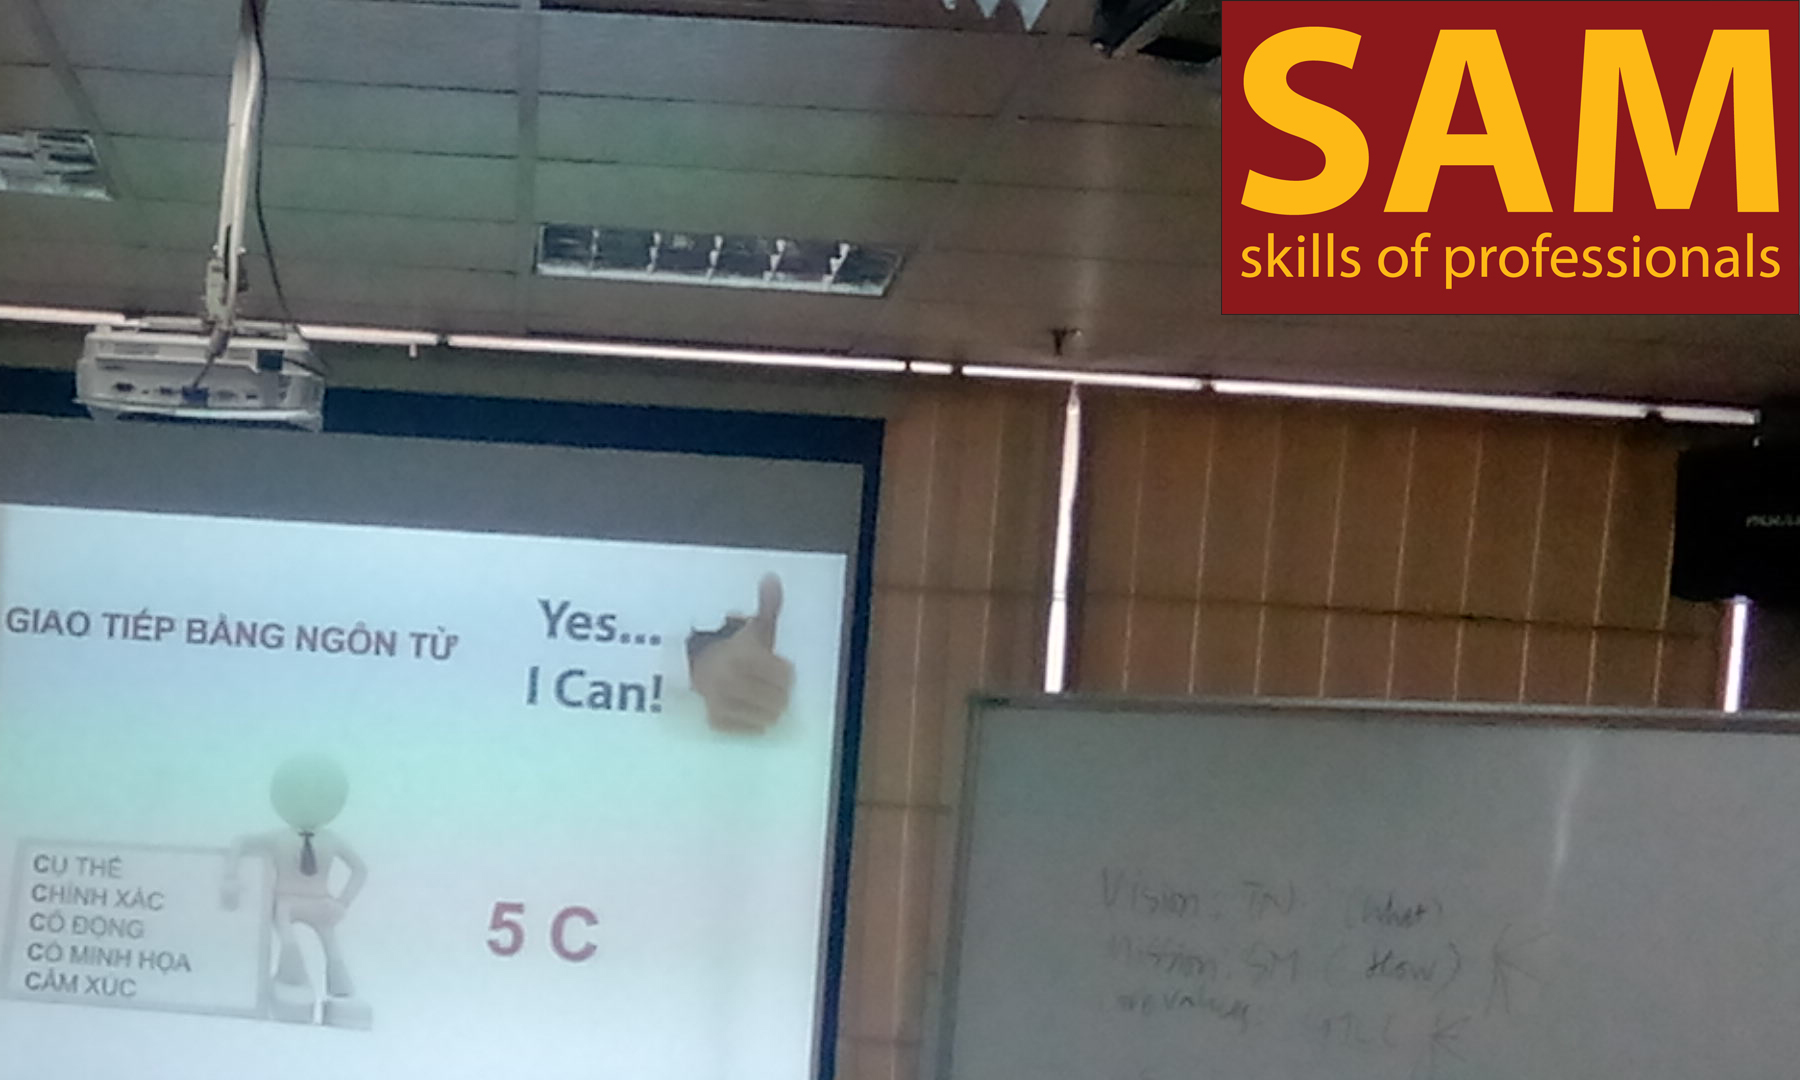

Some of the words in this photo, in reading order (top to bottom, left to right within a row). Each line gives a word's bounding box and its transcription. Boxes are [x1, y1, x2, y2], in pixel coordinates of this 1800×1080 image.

[5, 606, 91, 637] GIAO
[295, 620, 398, 657] NGÔN
[409, 625, 459, 660] TỪ
[537, 597, 662, 646] Yes...
[526, 665, 540, 706] I
[554, 667, 663, 713] Can!
[69, 945, 132, 968] MINH
[486, 901, 525, 957] 5
[550, 905, 599, 963] C
